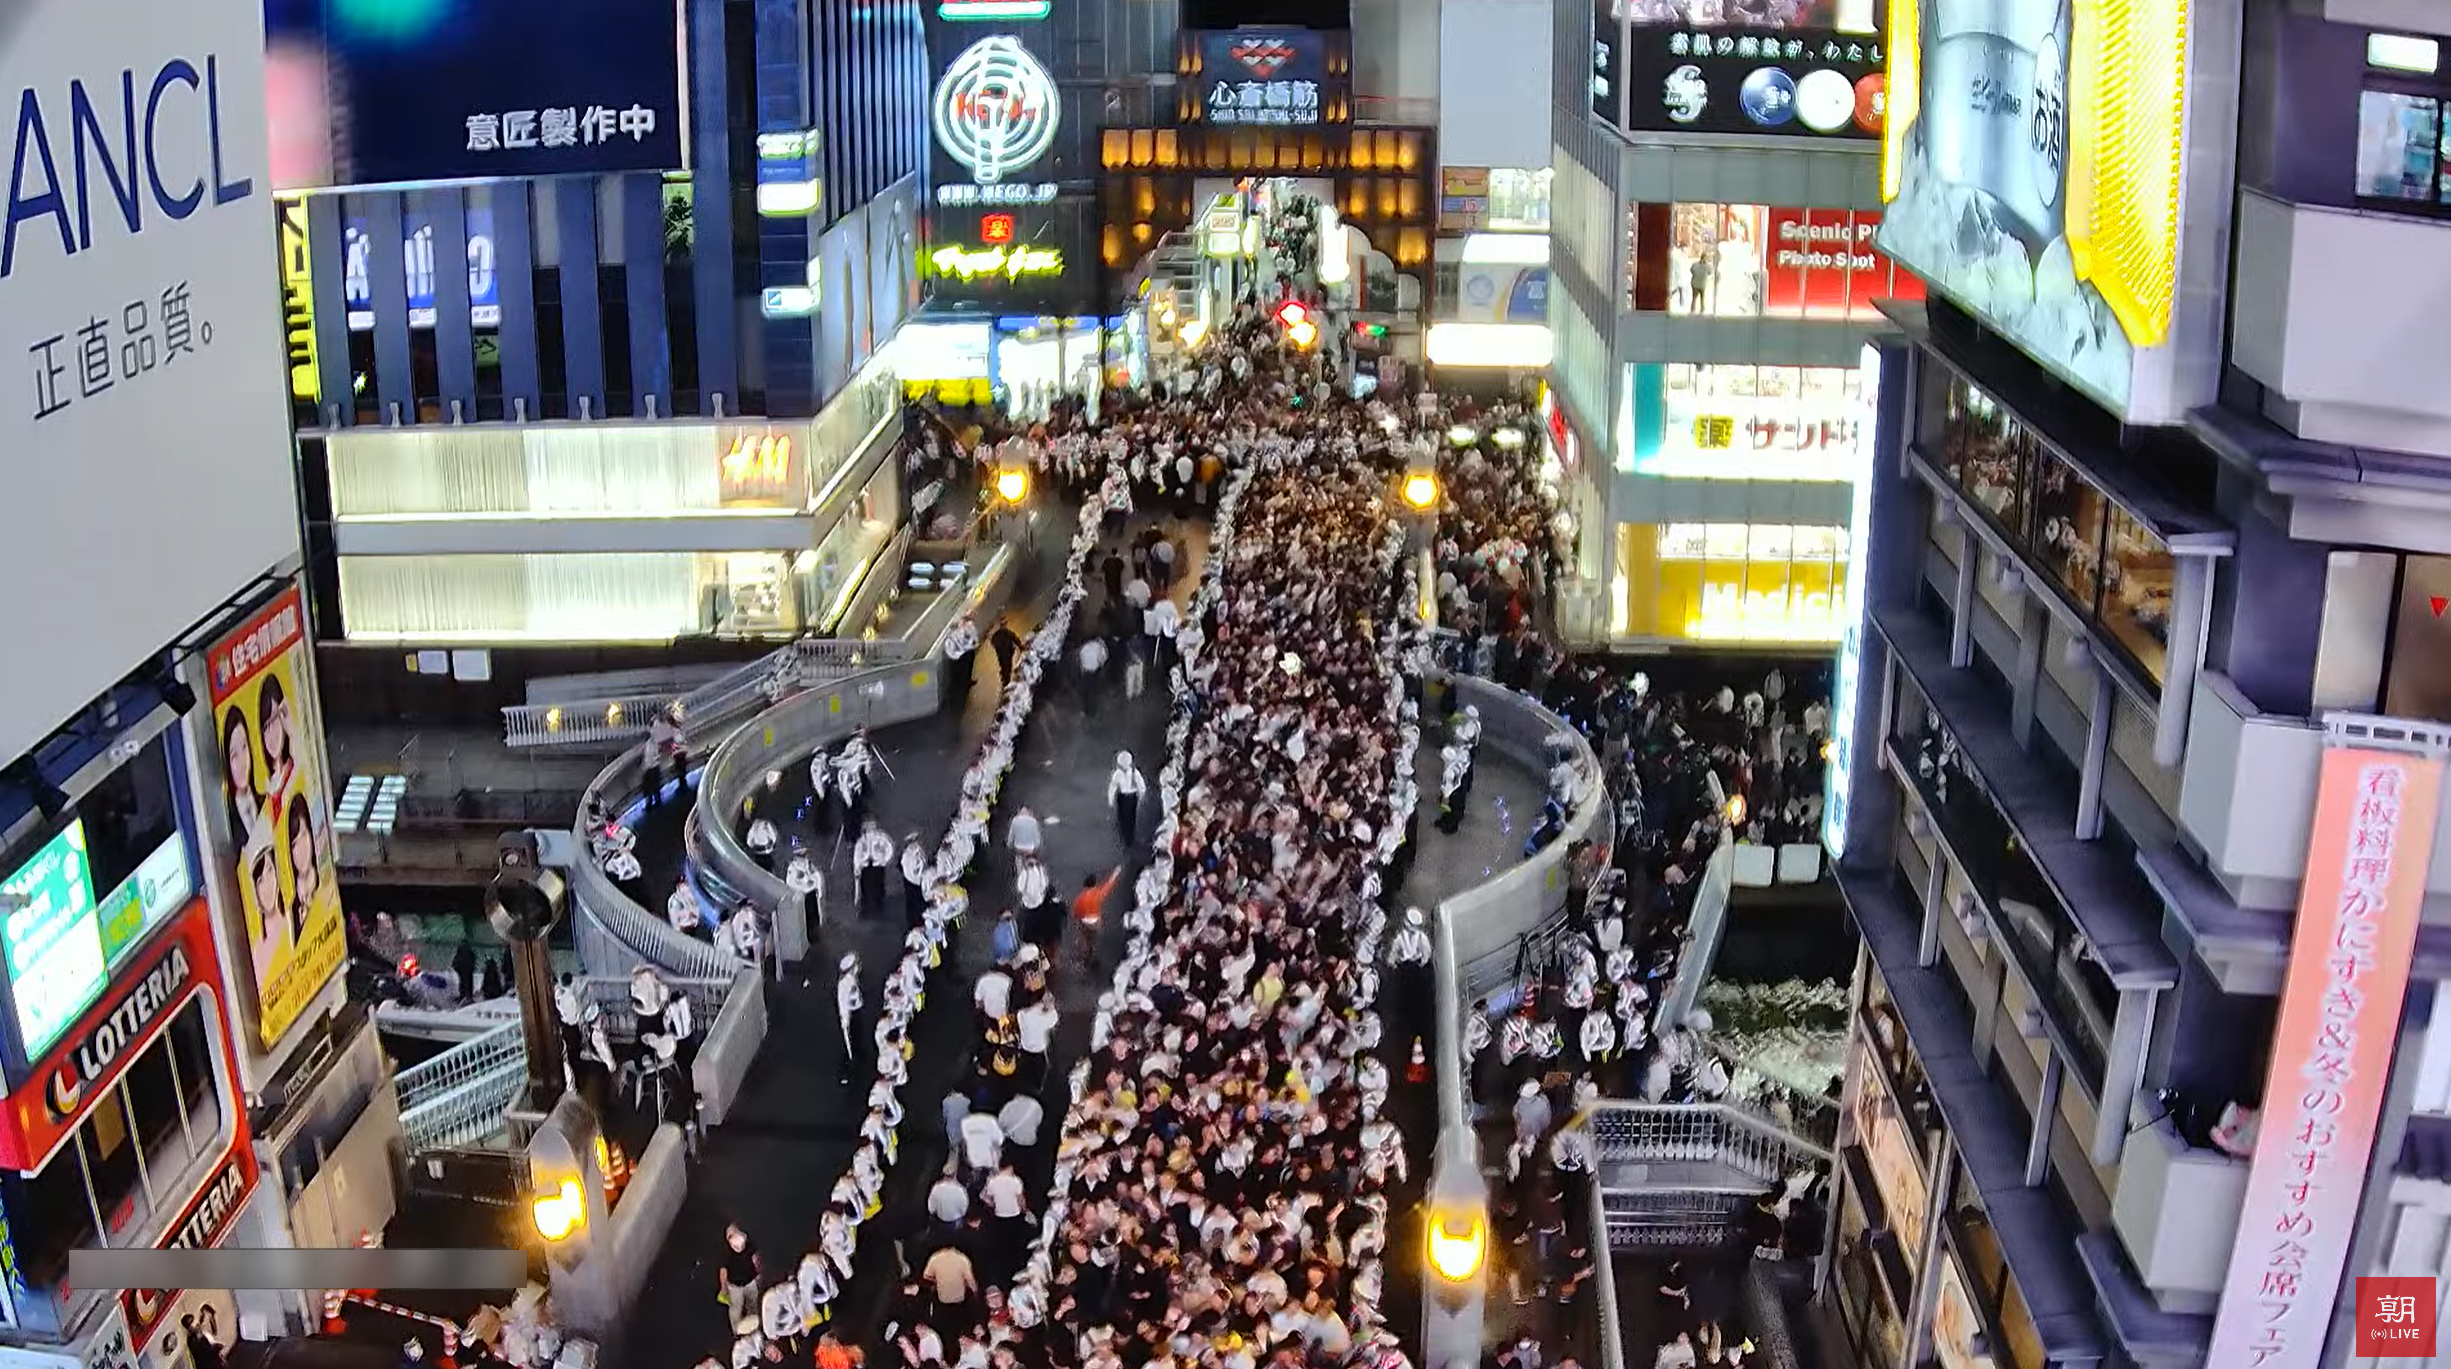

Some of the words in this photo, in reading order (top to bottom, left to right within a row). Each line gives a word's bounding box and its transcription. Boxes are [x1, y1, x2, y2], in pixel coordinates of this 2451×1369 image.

[1, 53, 252, 279] ANCL
[465, 104, 656, 152] 意匠製作中
[1780, 221, 1852, 241] Scenic
[29, 280, 214, 421] 正直品質。
[80, 948, 189, 1081] LOTTERIA
[171, 1162, 244, 1249] TTERIA
